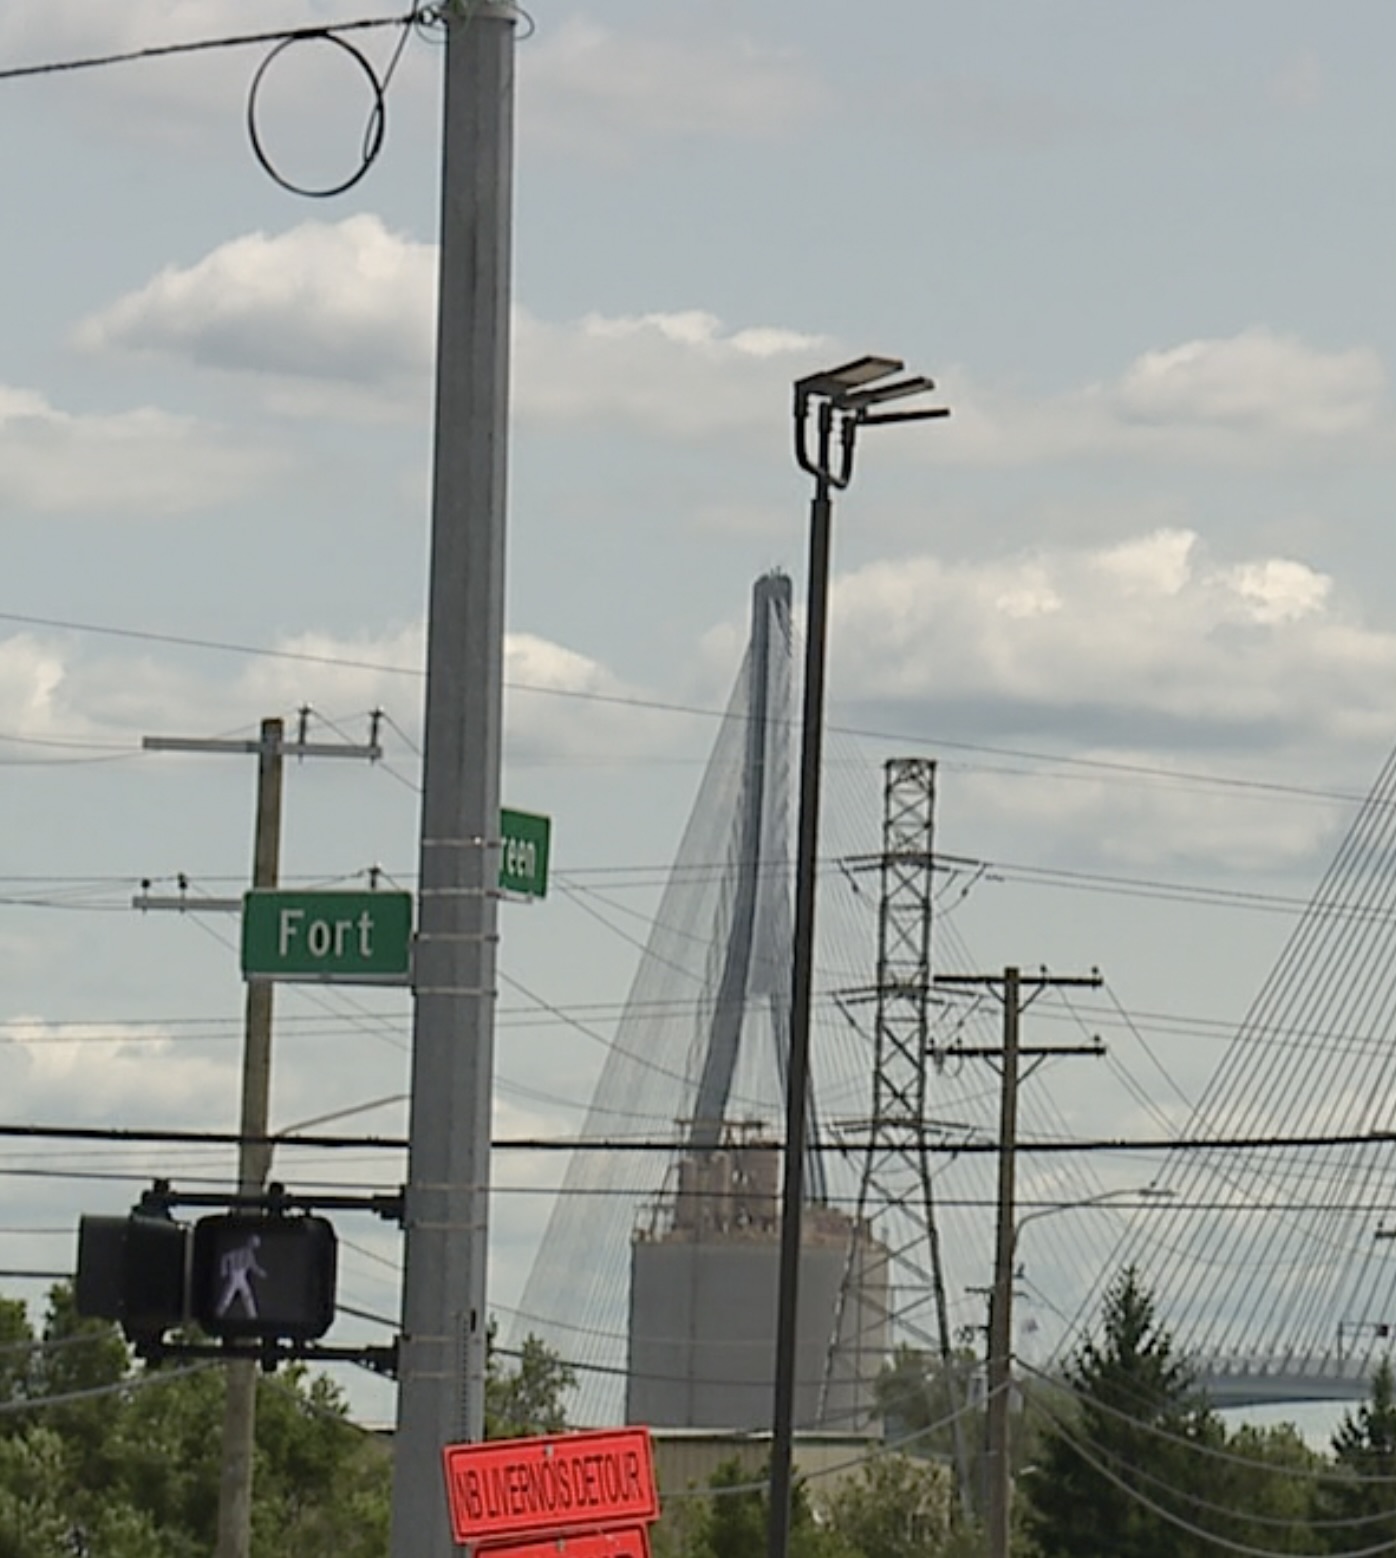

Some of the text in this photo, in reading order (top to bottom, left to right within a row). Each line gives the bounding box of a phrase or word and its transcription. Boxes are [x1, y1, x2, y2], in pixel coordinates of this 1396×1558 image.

[500, 836, 536, 878] reen
[278, 909, 375, 957] Fort
[455, 1451, 644, 1520] NB LIVERNOIS DETOUR
